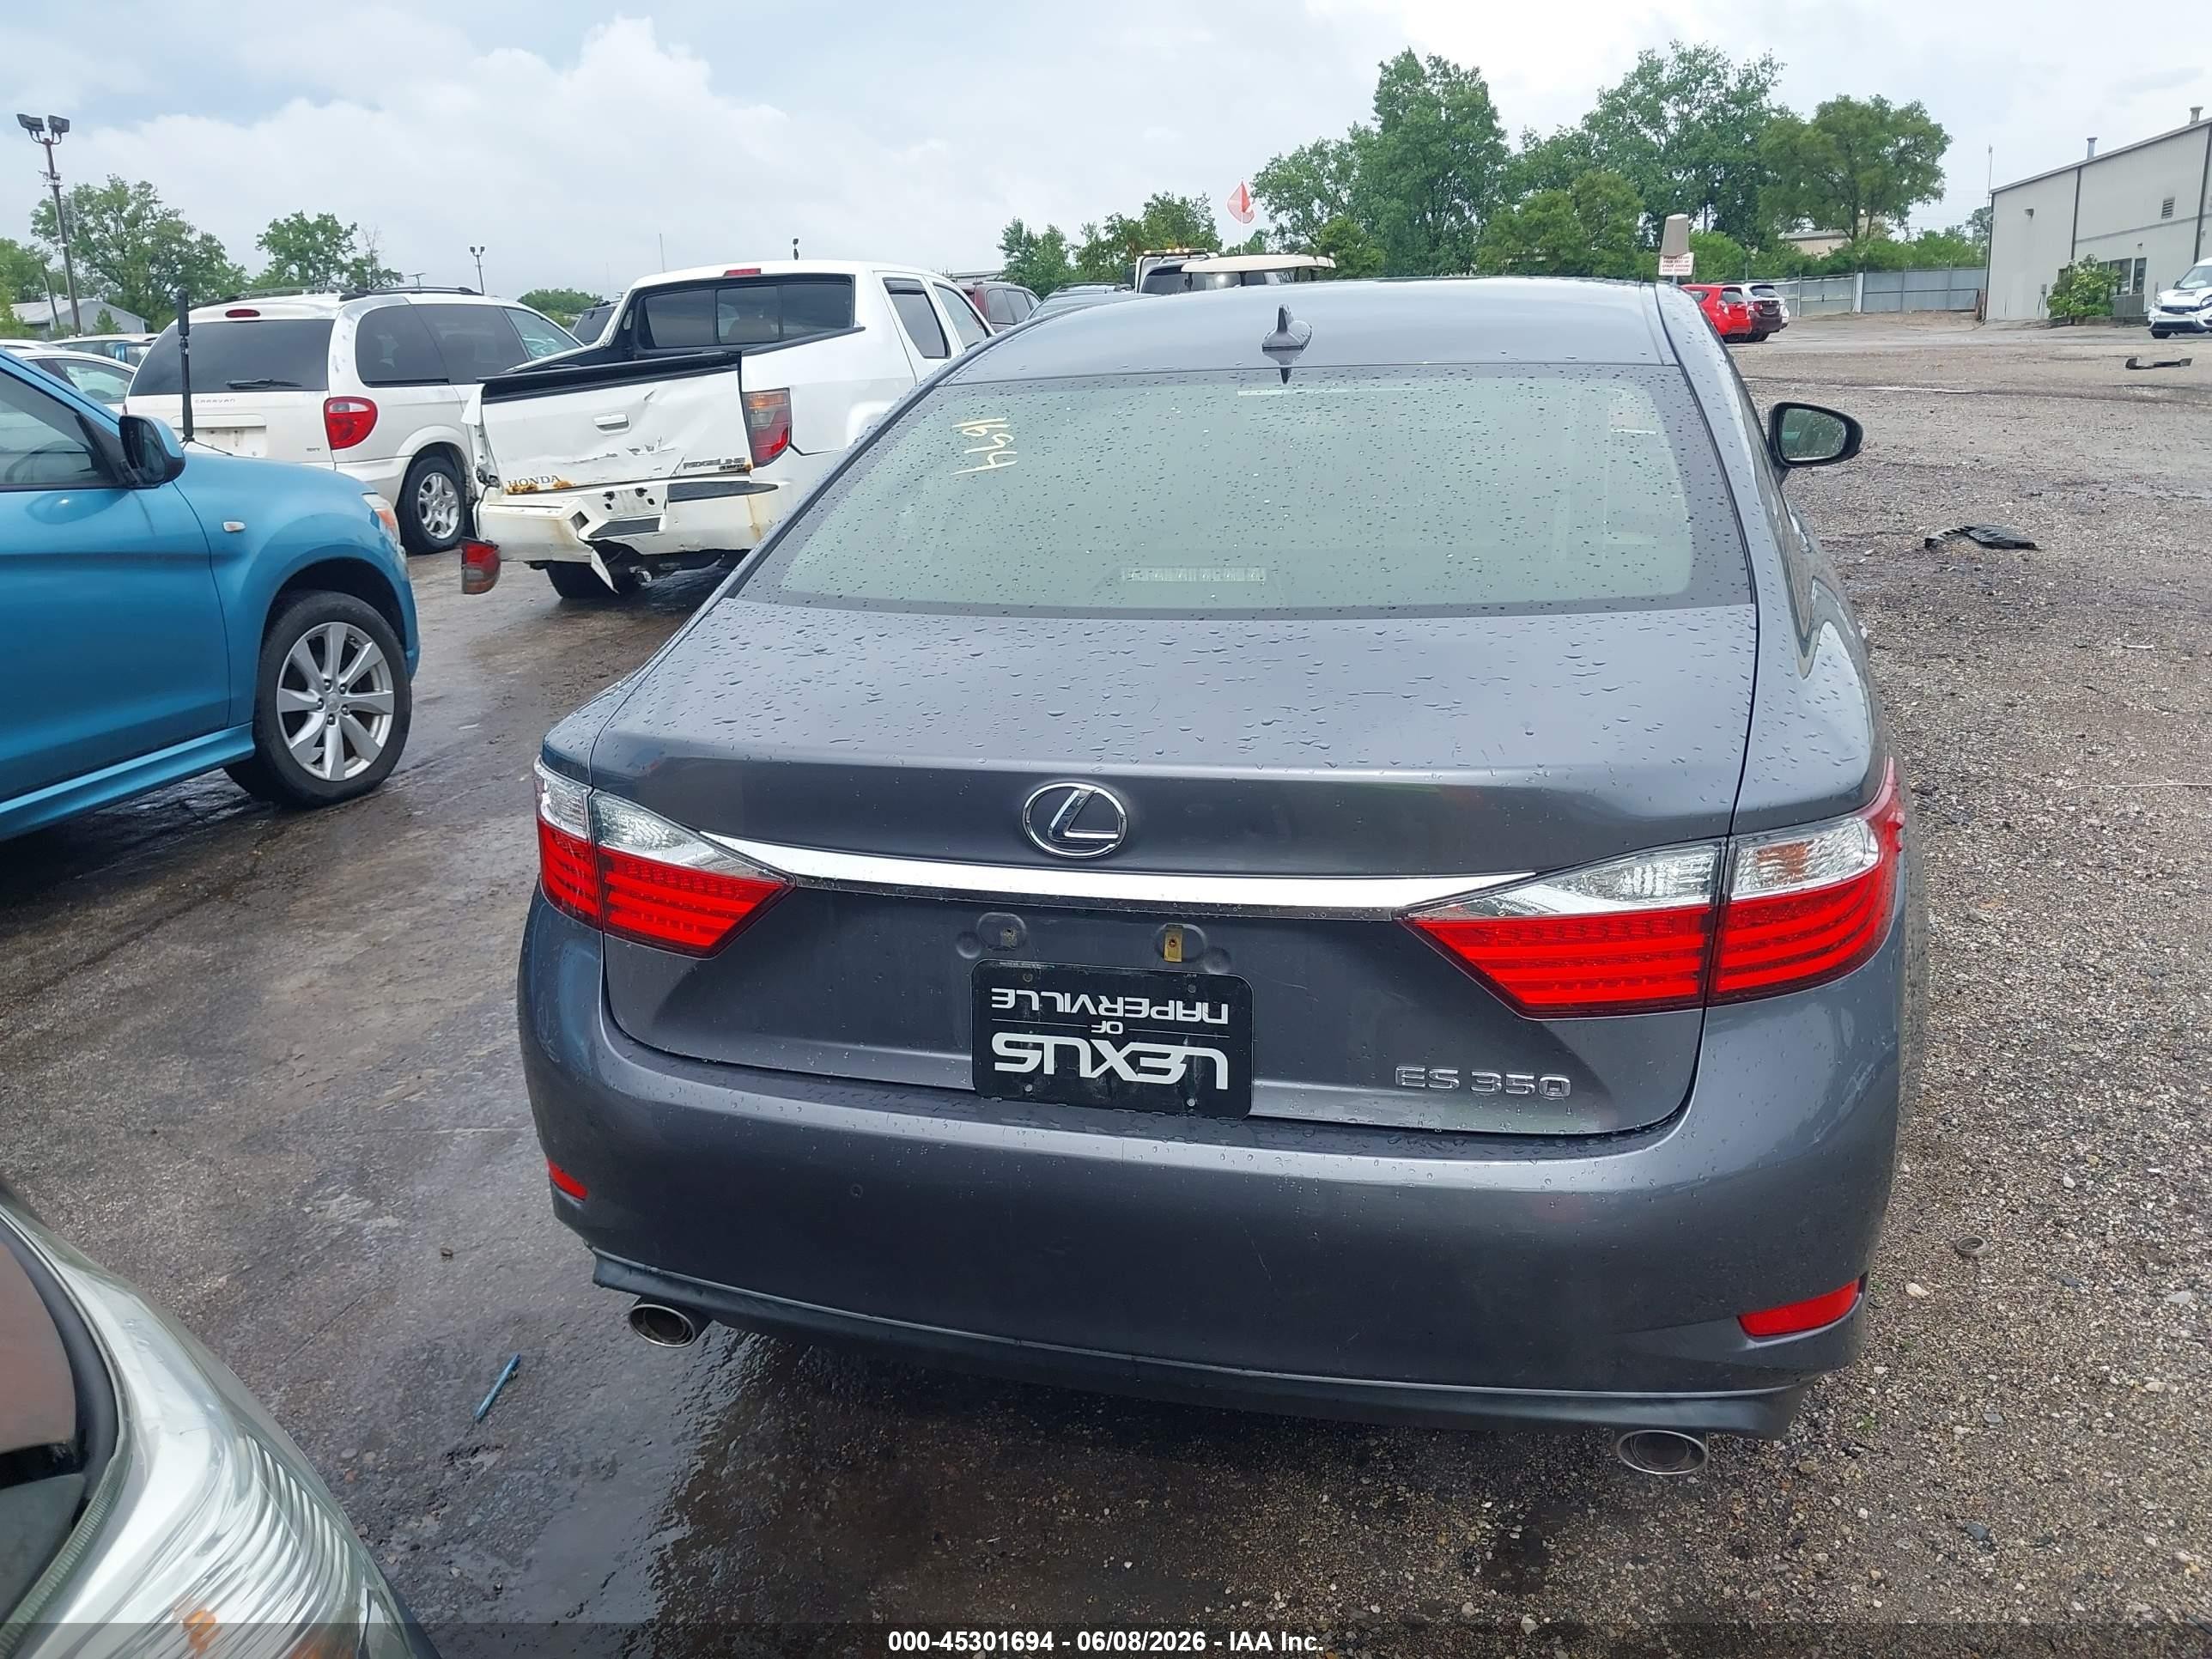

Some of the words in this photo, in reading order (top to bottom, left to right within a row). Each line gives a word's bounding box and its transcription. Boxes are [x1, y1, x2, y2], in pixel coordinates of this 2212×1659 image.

[950, 416, 1018, 476] 1694
[507, 475, 562, 488] HONDA
[991, 988, 1229, 1024] NAPERVILLE
[1091, 1021, 1124, 1035] OF
[991, 1032, 1229, 1090] LEXUS
[1395, 1065, 1460, 1090] ES
[1470, 1071, 1571, 1099] 350
